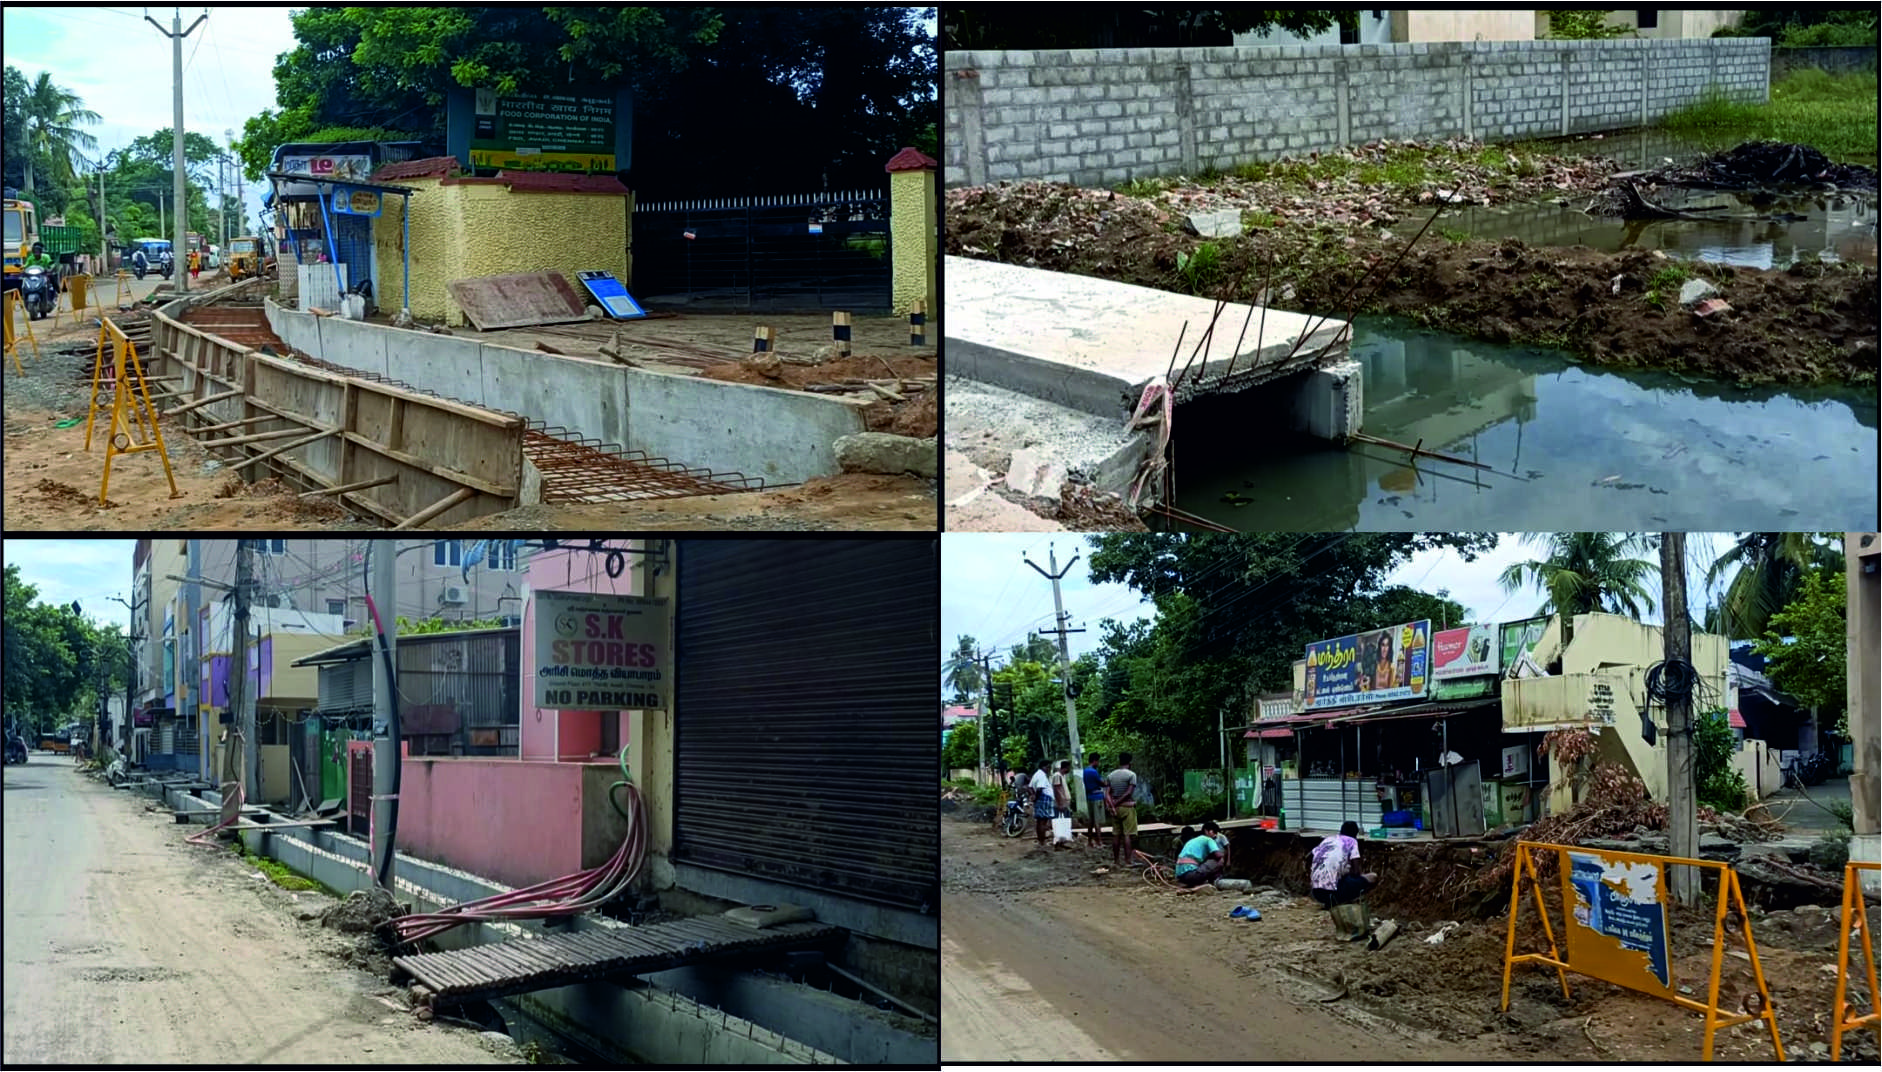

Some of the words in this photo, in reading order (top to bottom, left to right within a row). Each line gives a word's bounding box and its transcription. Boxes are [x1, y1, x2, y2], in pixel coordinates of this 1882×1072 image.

[500, 110, 522, 118] FOOD
[524, 111, 578, 121] CORPORATION
[585, 613, 624, 640] S.K
[552, 639, 656, 668] STORES
[545, 690, 571, 705] NO
[576, 690, 659, 707] PARKING
